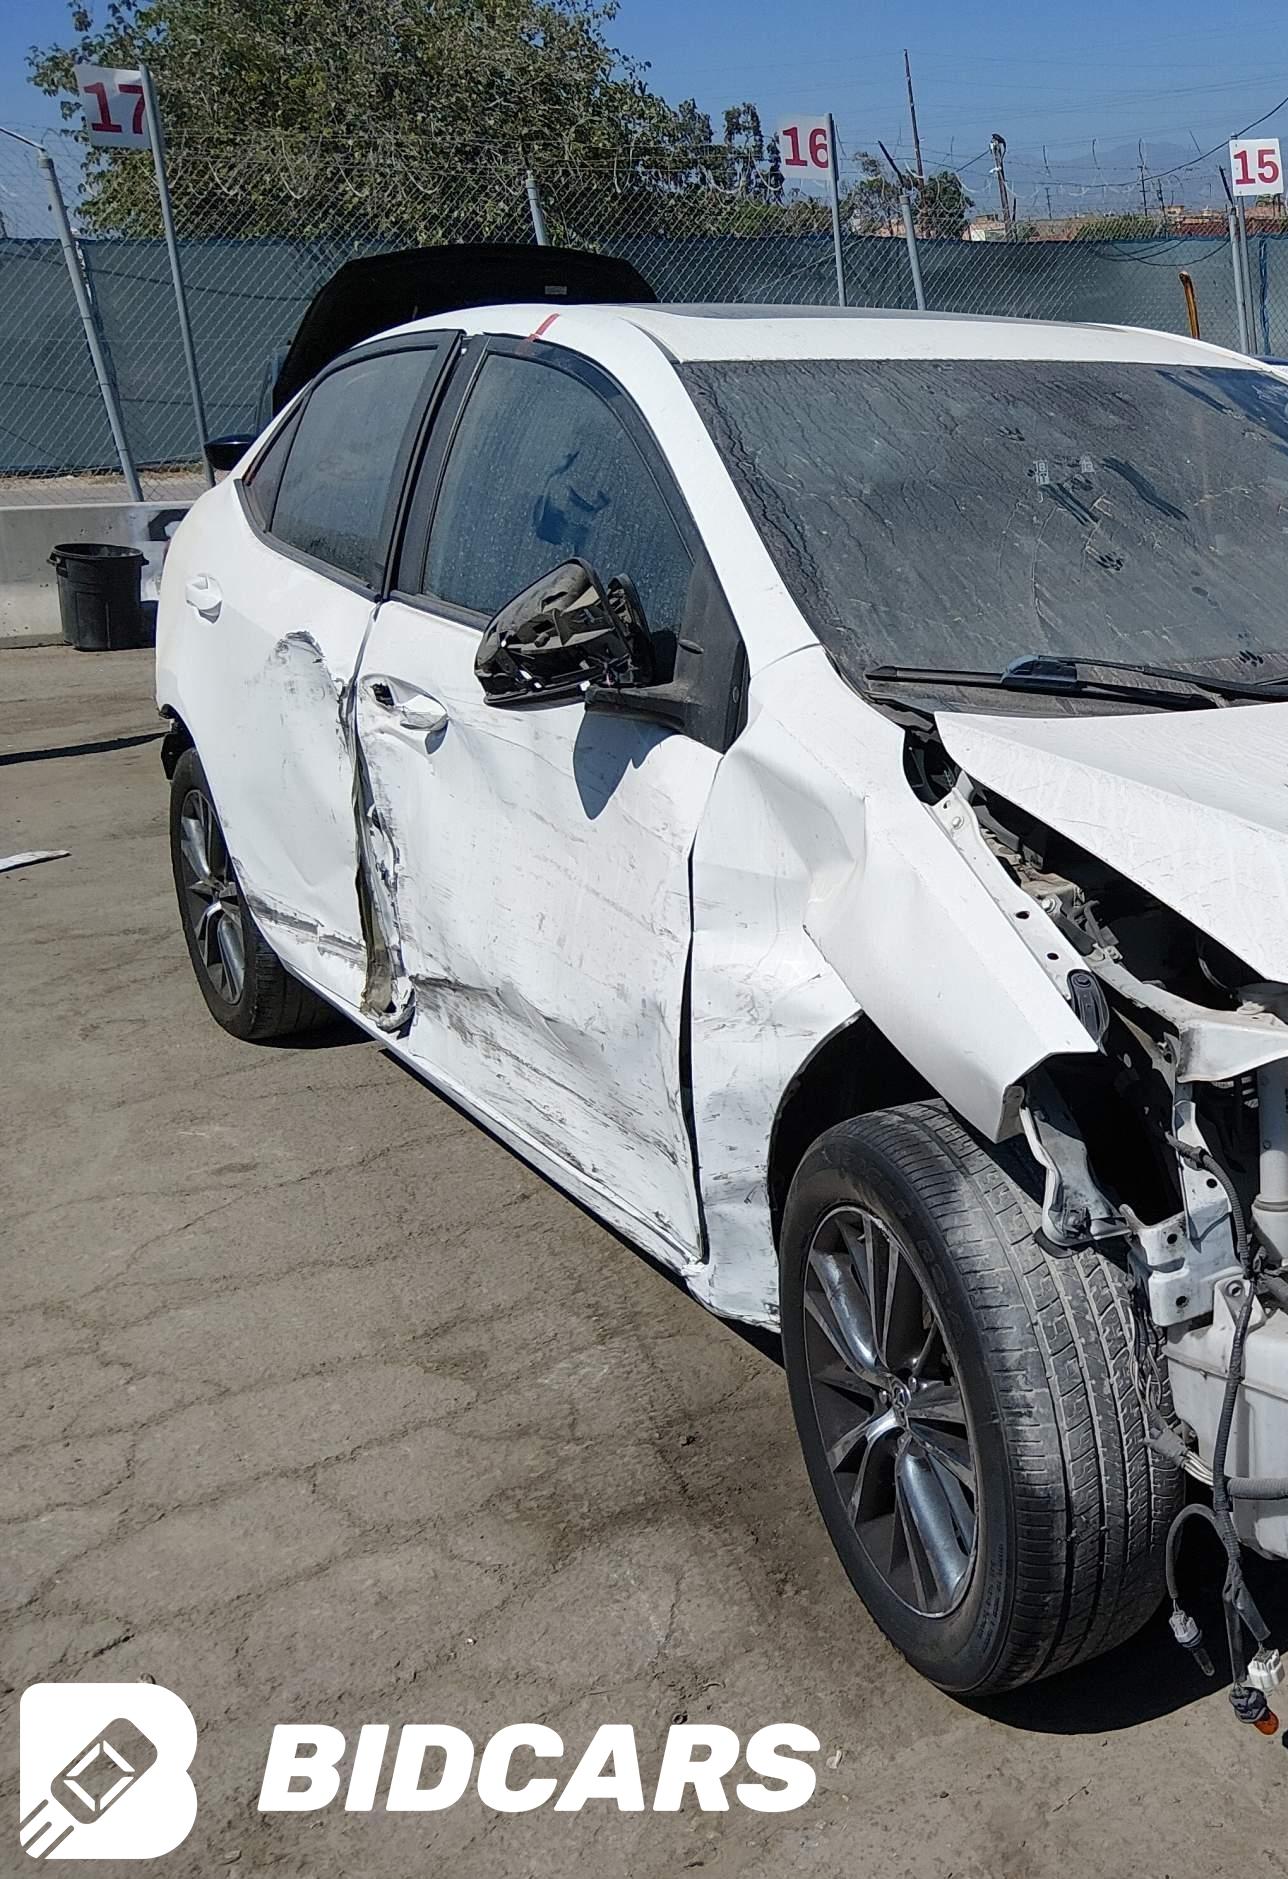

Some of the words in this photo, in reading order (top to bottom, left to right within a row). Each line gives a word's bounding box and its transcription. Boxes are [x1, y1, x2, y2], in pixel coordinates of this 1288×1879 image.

[83, 82, 146, 135] 17
[781, 126, 829, 169] 16
[1233, 149, 1280, 185] 15
